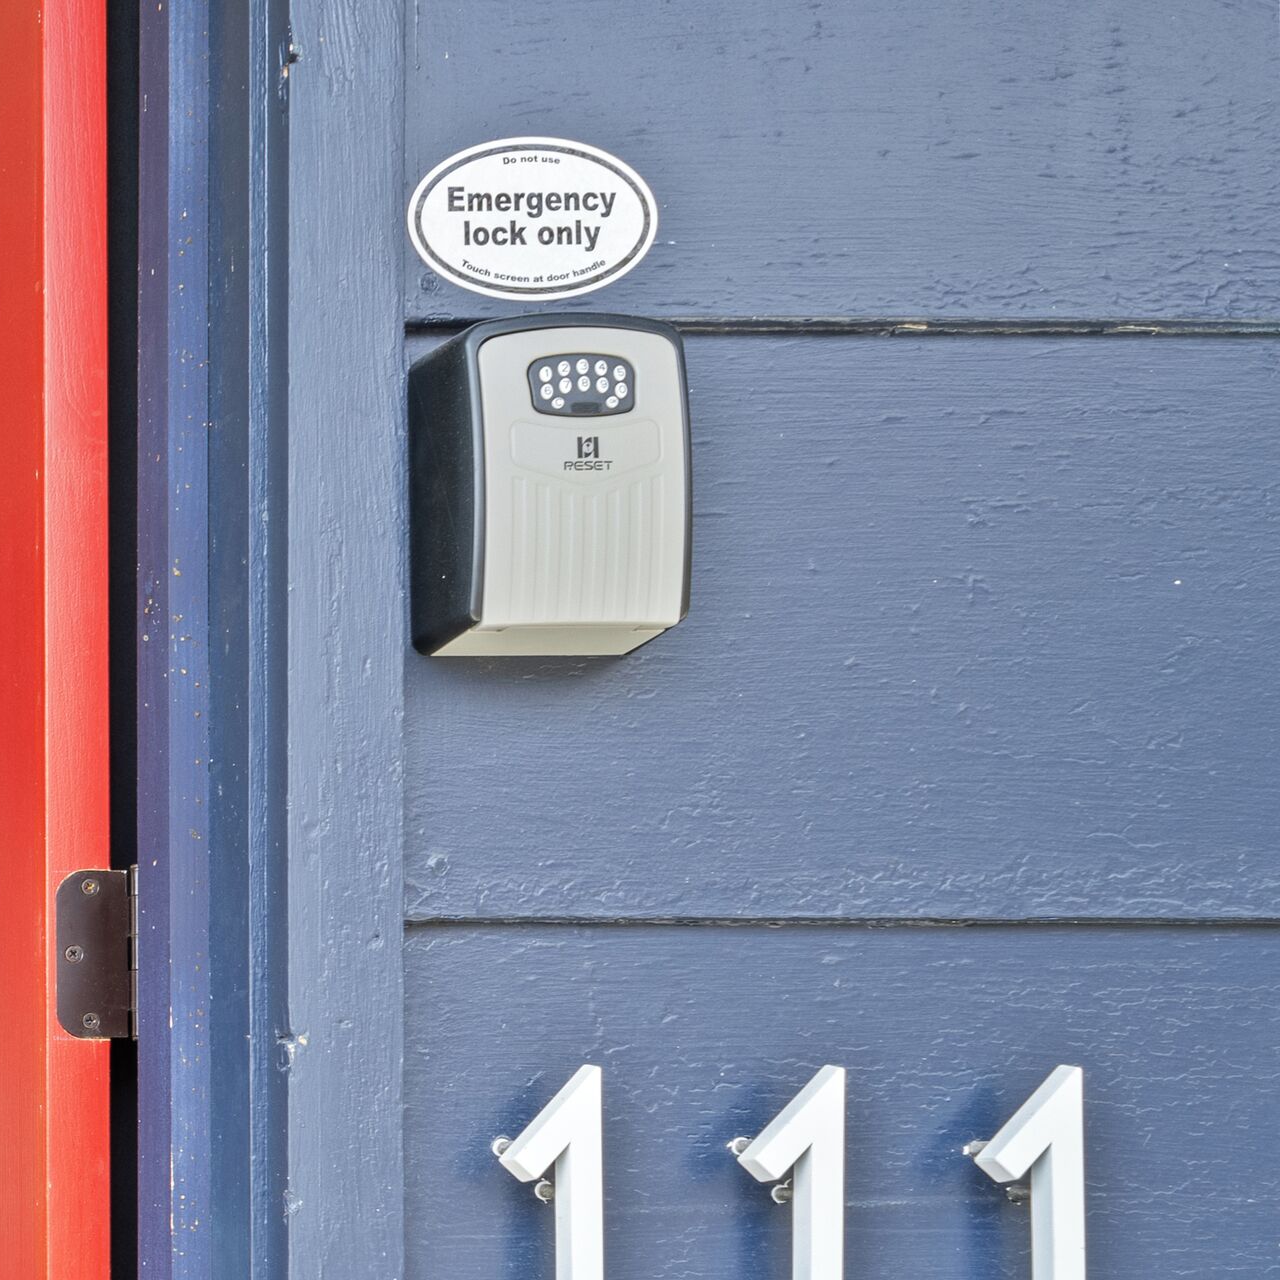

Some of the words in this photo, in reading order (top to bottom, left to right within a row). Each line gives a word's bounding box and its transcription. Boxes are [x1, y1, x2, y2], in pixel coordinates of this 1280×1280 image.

[503, 157, 517, 165] Do
[520, 155, 538, 163] not
[541, 156, 561, 164] use
[447, 186, 616, 218] Emergency
[464, 220, 527, 246] lock
[537, 219, 601, 252] only
[461, 259, 490, 277] Touch
[494, 273, 530, 283] screen
[533, 275, 543, 283] at
[547, 272, 570, 282] door
[572, 259, 606, 278] handle
[563, 460, 613, 471] RESET
